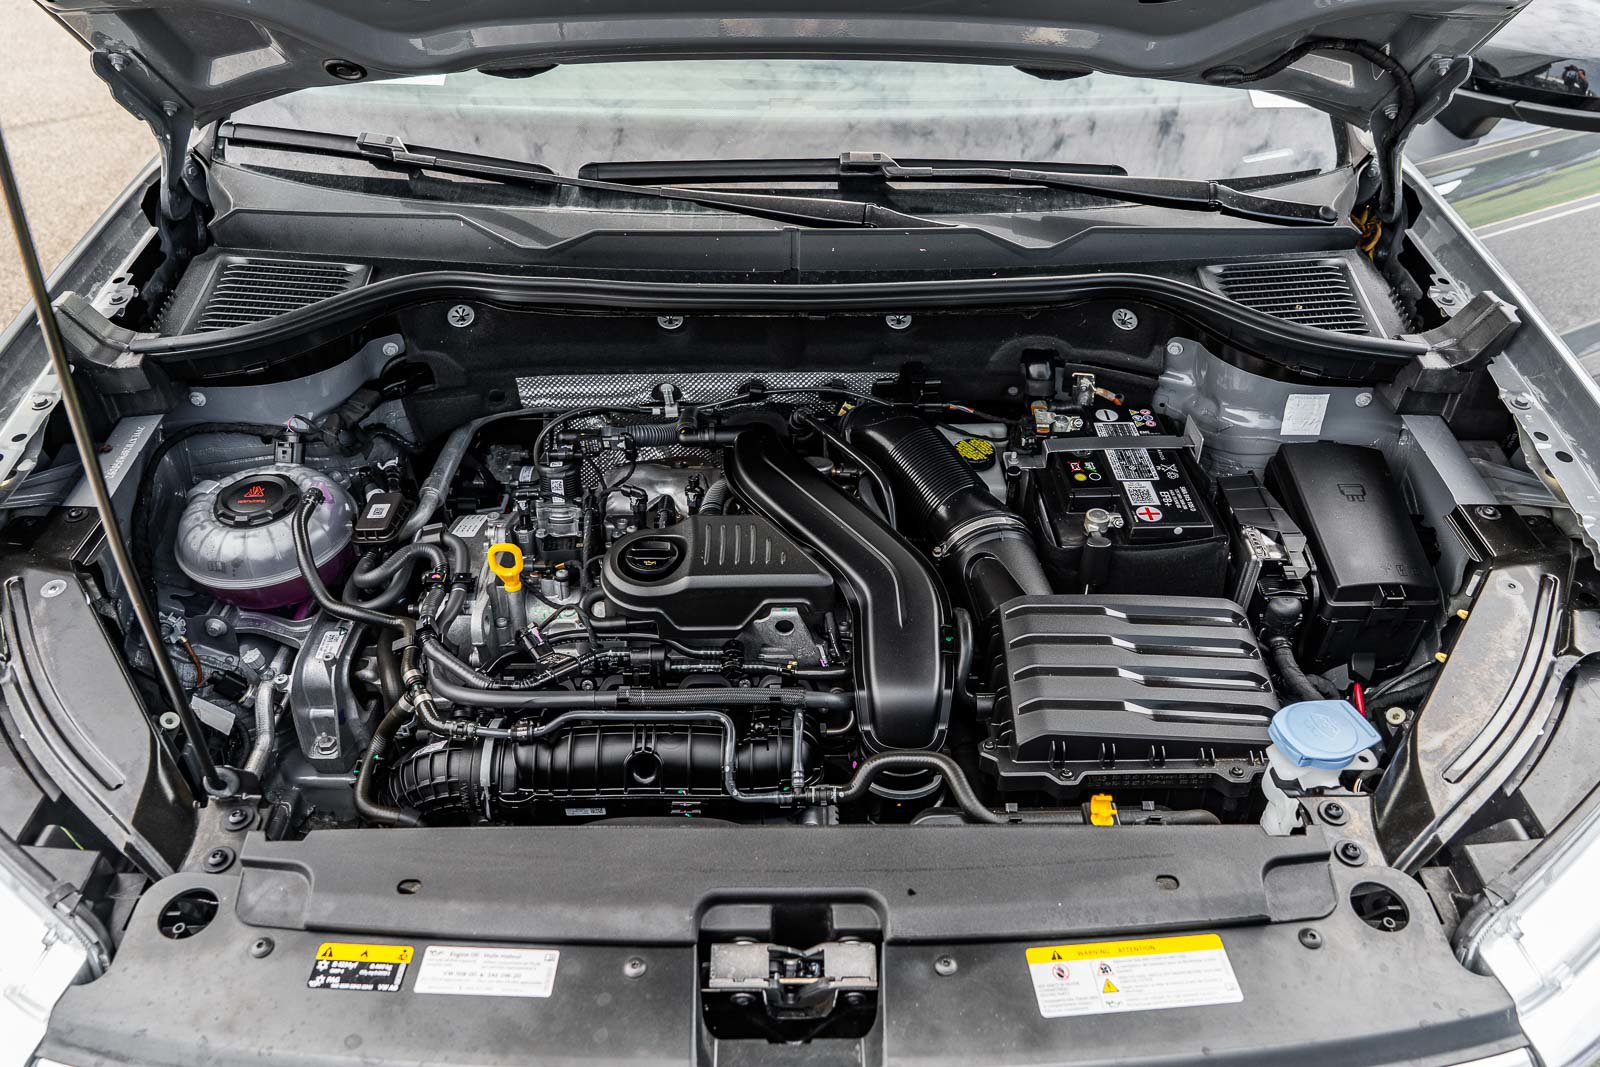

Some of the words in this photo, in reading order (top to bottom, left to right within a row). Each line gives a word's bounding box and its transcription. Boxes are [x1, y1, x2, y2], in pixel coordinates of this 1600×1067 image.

[1159, 491, 1173, 507] EFB+
[449, 951, 469, 959] Engine
[1077, 949, 1110, 957] WARNING
[1118, 944, 1156, 953] ATTENTION
